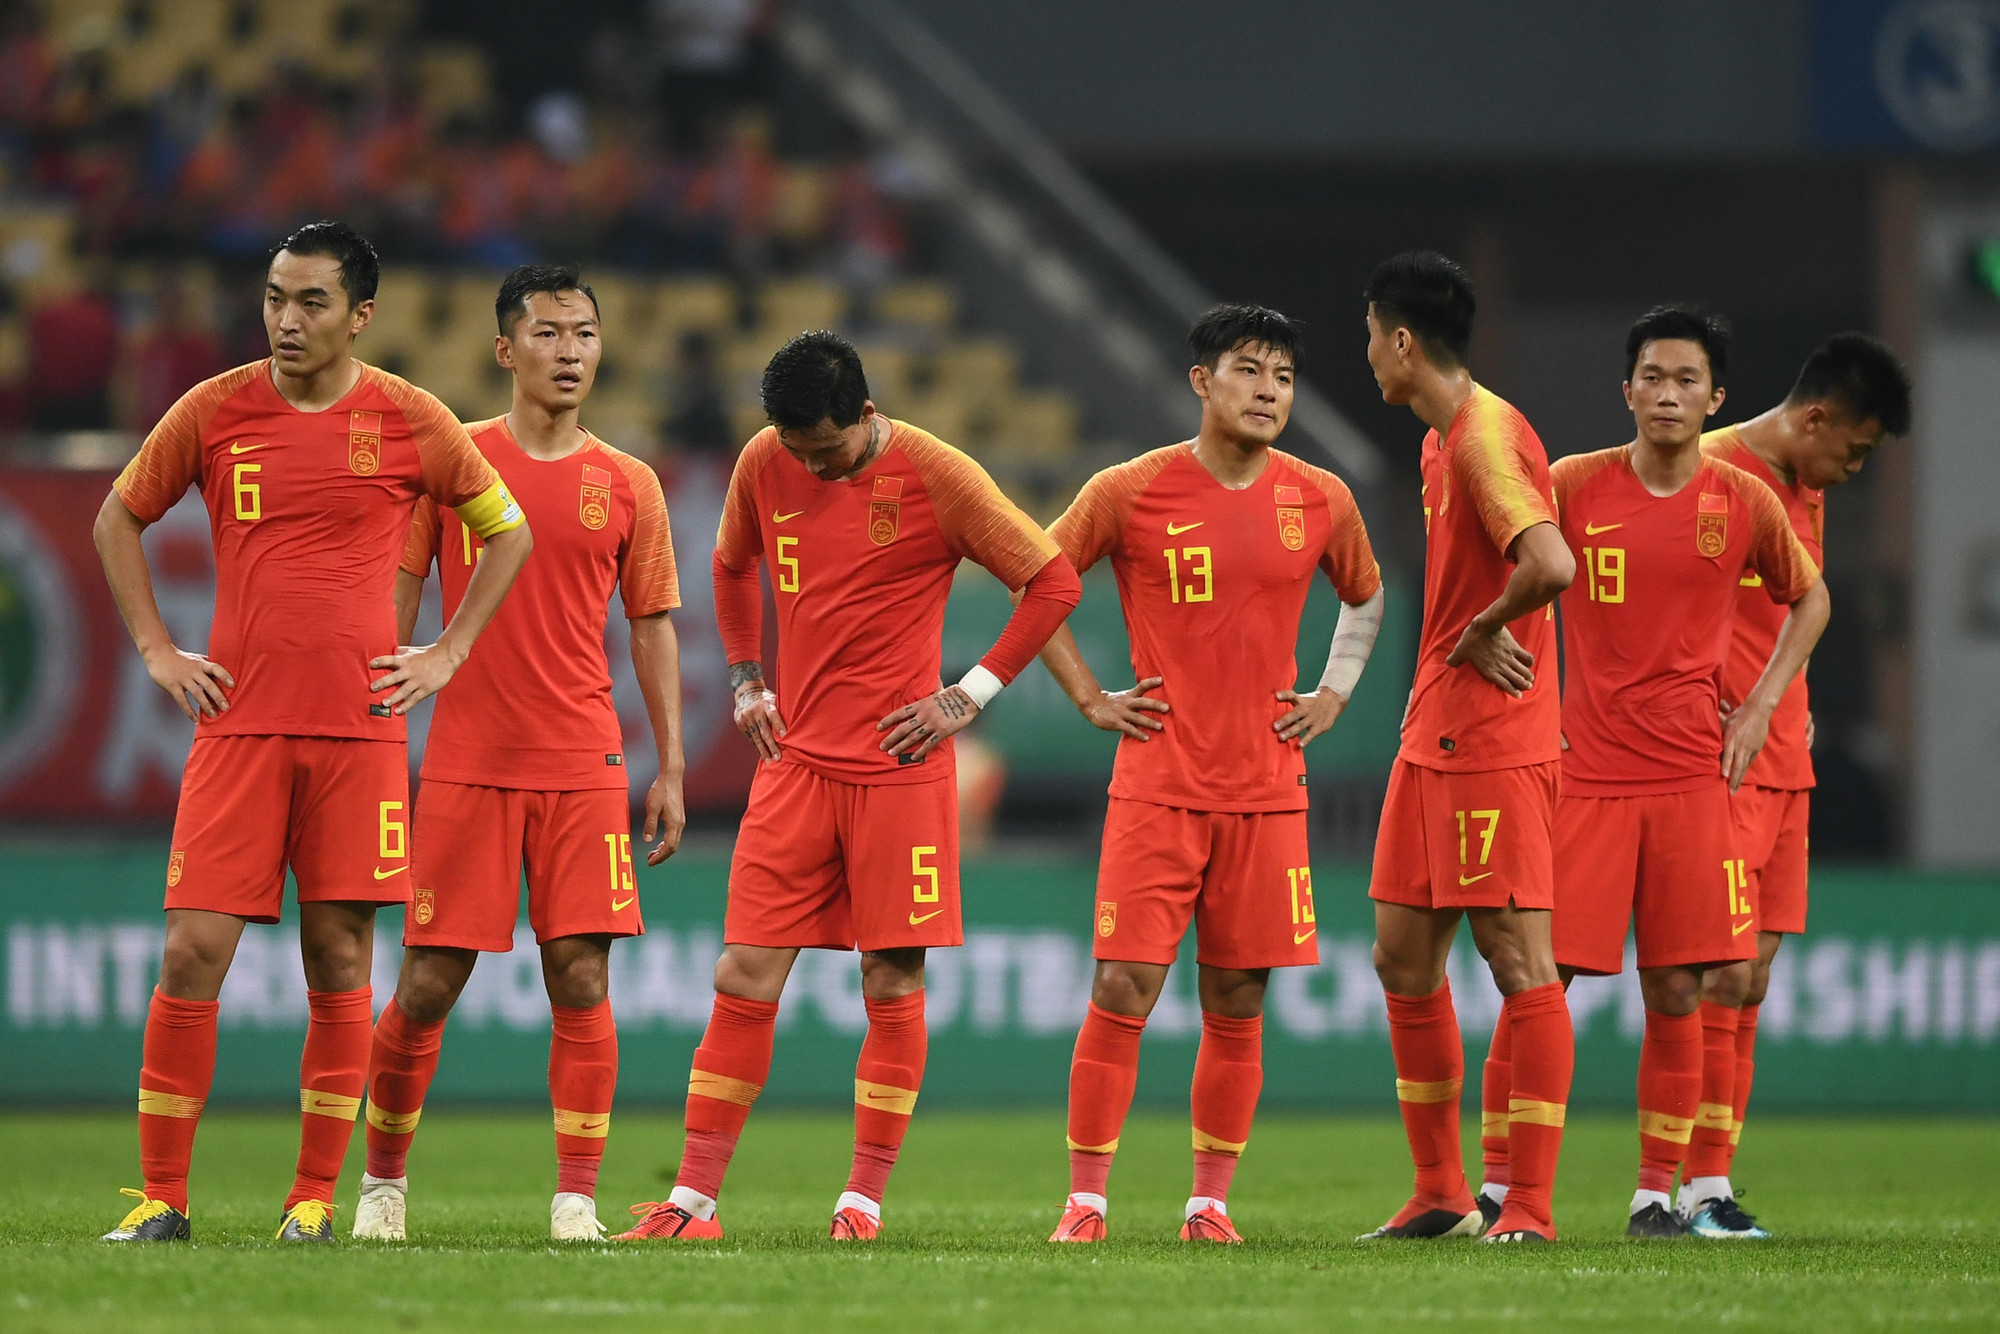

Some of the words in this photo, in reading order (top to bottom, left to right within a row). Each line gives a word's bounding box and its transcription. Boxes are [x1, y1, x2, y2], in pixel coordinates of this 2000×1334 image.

[353, 435, 377, 446] CFA
[234, 463, 261, 520] 6
[583, 489, 607, 500] CFA
[873, 504, 897, 514] CFA
[1280, 511, 1300, 520] CFA
[462, 521, 484, 565] 1
[1700, 517, 1724, 527] CFA
[777, 536, 799, 593] 5
[1163, 546, 1213, 603] 13
[1582, 547, 1625, 604] 19
[171, 853, 183, 861] CFA
[380, 801, 405, 858] 6
[1455, 809, 1500, 865] 17
[604, 834, 633, 890] 15
[912, 846, 939, 902] 5
[417, 891, 433, 899] CFA
[1287, 866, 1315, 924] 13
